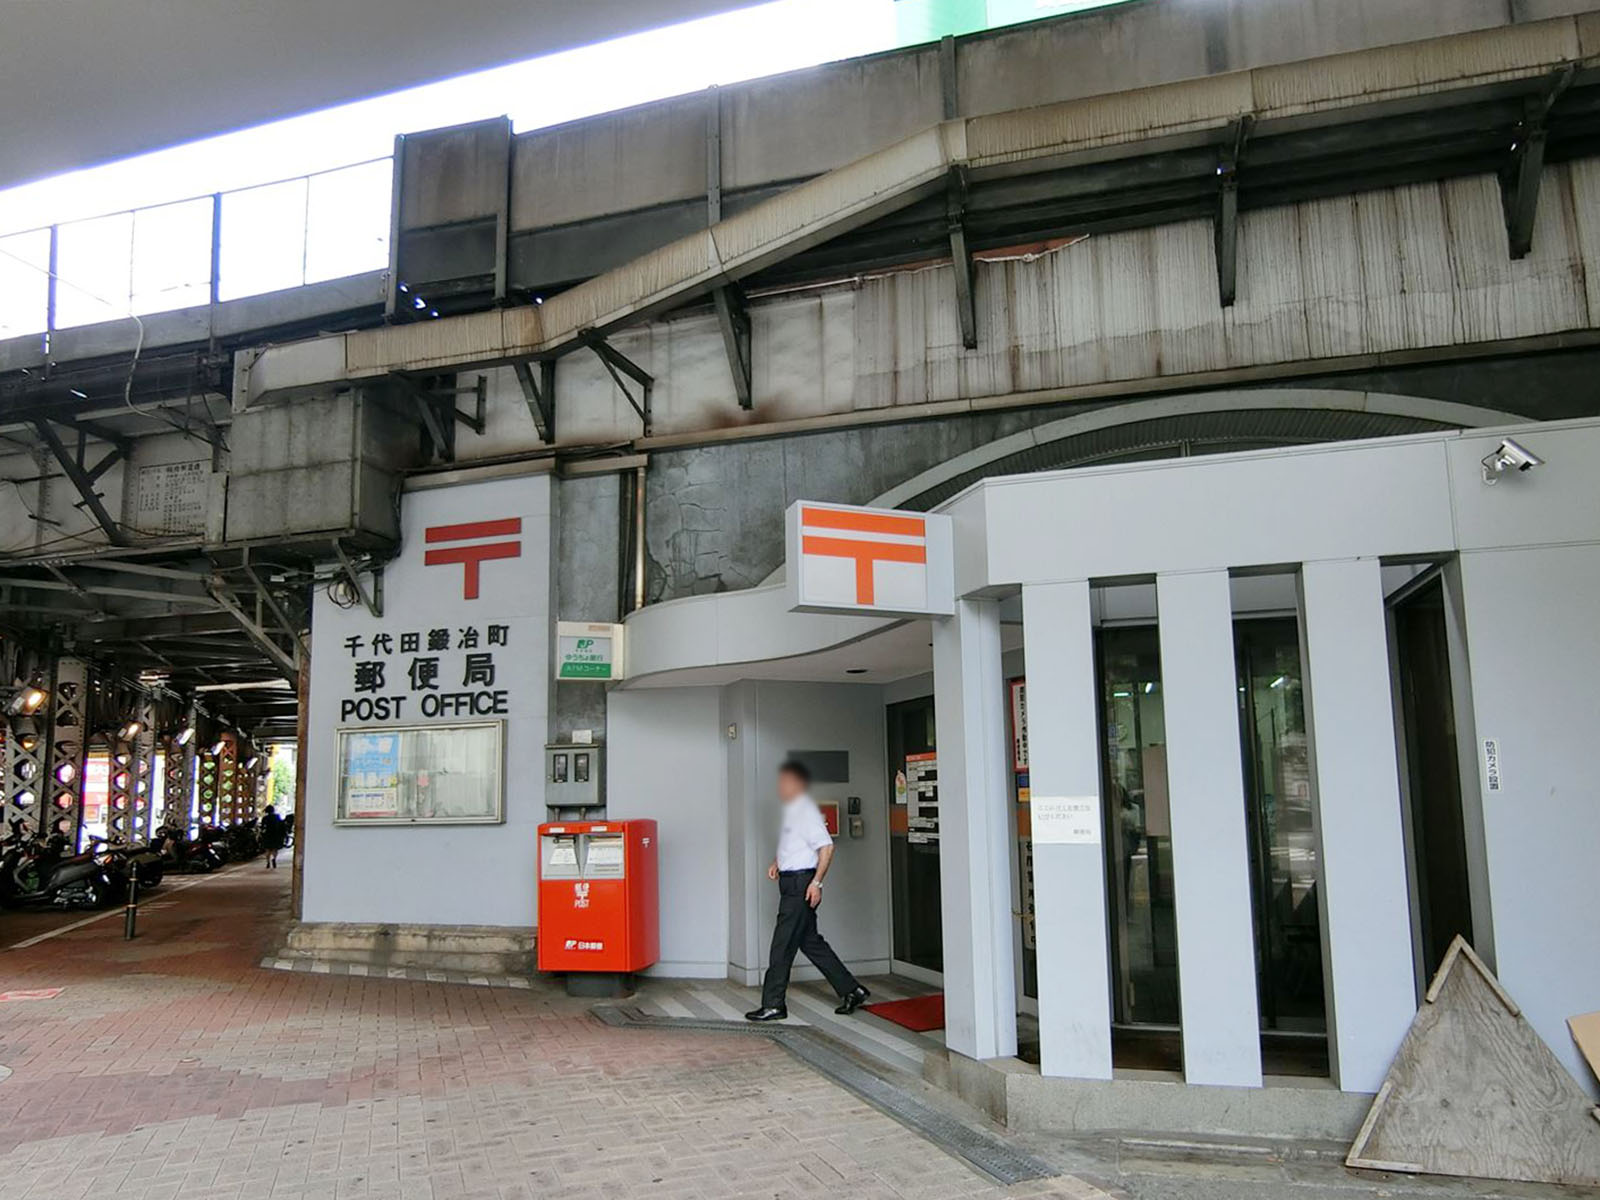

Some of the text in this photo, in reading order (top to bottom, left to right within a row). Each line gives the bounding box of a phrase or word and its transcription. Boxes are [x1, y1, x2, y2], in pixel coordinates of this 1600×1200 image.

[344, 625, 509, 657] 千代田鍛冶町
[355, 653, 495, 693] 郵便局
[341, 690, 508, 722] POST OFFICE
[1485, 741, 1499, 790] 防犯カメラ設置
